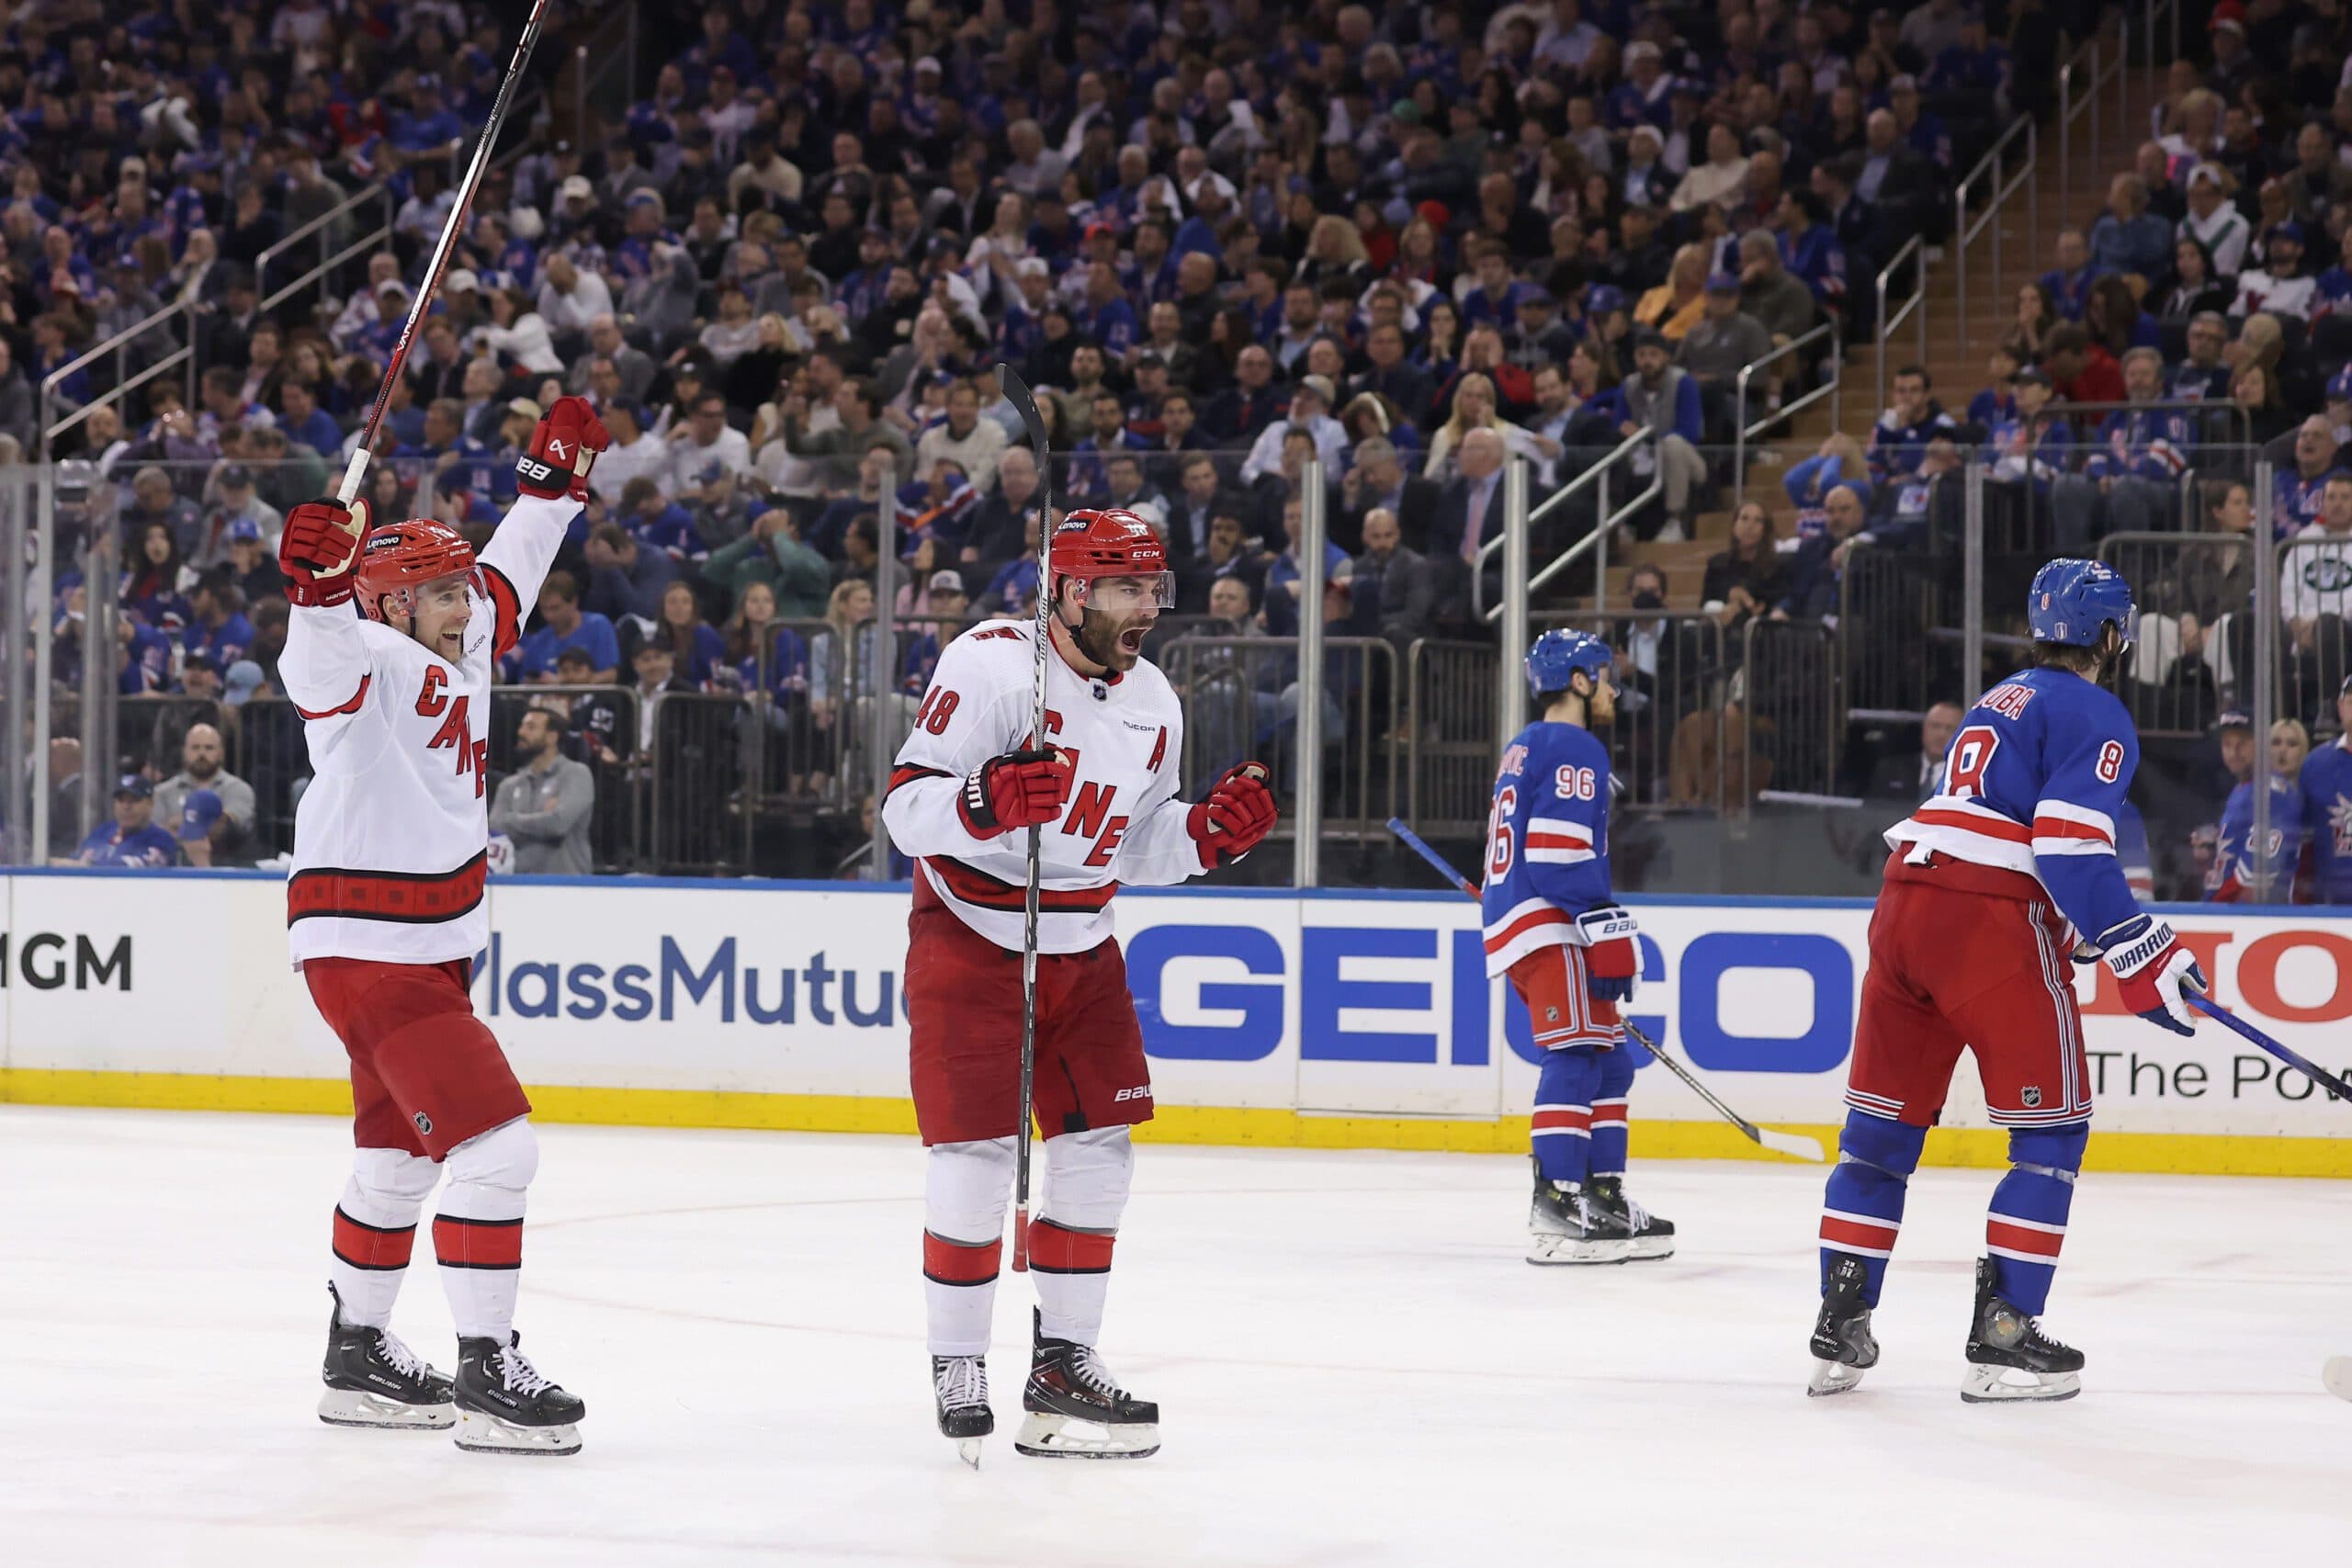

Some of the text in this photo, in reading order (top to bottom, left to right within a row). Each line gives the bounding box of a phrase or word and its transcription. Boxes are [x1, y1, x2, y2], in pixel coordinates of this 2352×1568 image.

[367, 536, 400, 549] Lenovo
[1058, 522, 1087, 531] Lenovo
[1131, 550, 1160, 558] CCM
[915, 684, 961, 736] 48
[1147, 725, 1167, 773] A
[2095, 739, 2125, 784] 8
[1555, 763, 1596, 801] 96
[0, 932, 131, 990] GM
[469, 930, 910, 1027] assMutu
[2085, 1052, 2208, 1097] The
